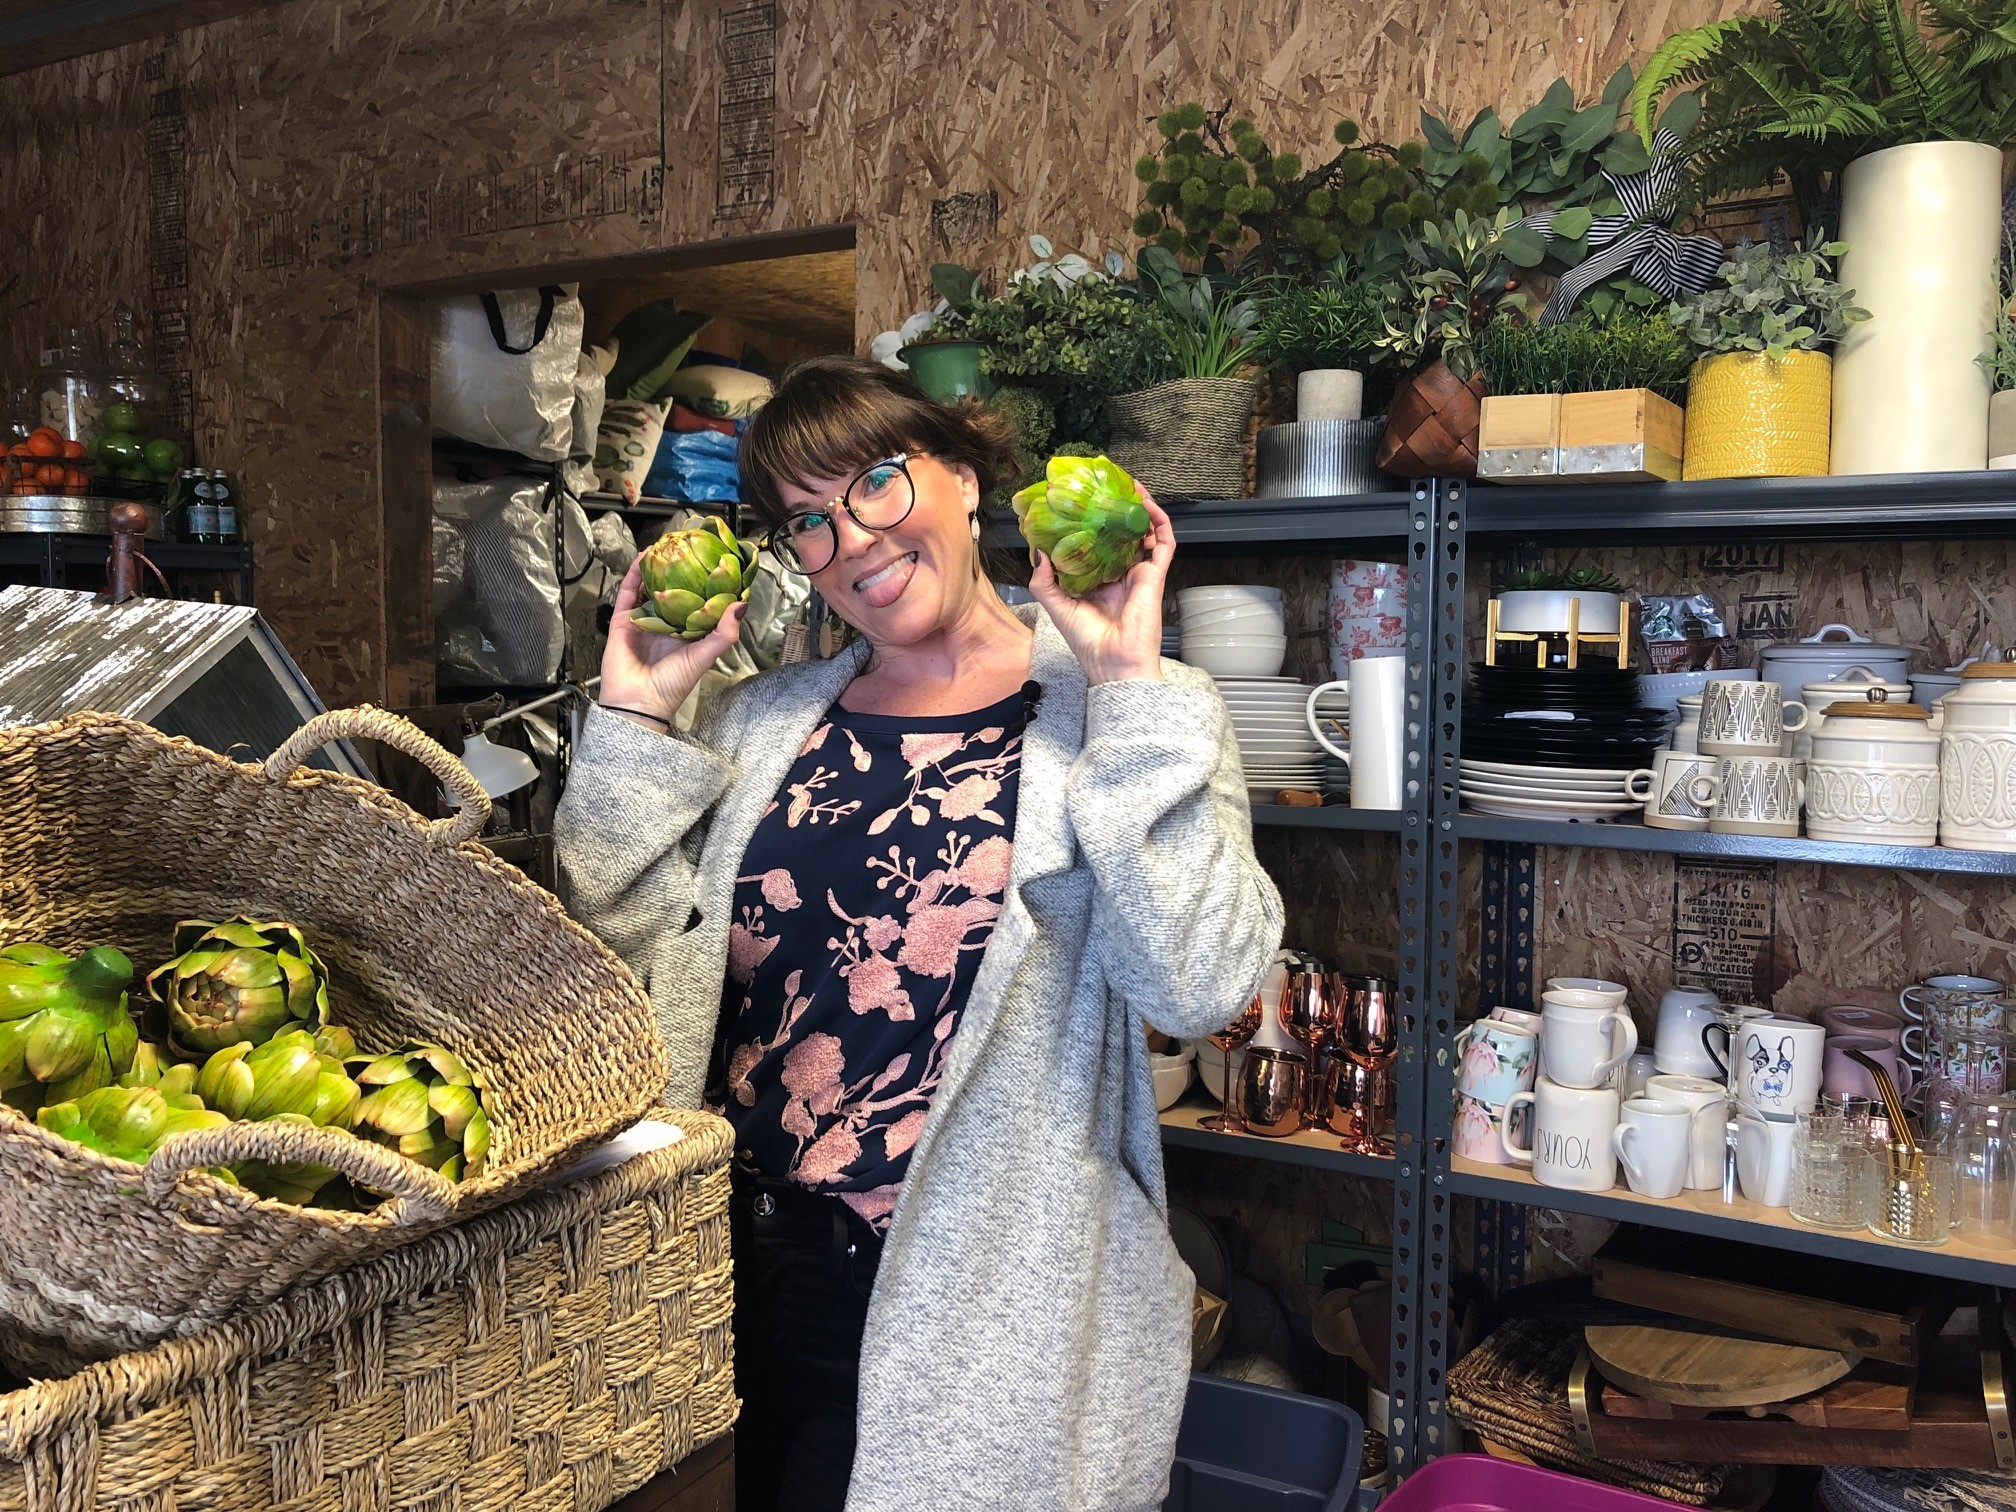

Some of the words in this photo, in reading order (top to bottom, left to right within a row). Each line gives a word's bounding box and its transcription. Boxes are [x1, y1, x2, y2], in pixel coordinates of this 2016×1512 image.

[1708, 543, 1775, 566] 2017
[1744, 602, 1793, 629] JAN
[1651, 646, 1688, 656] BREAKFAST
[1652, 656, 1670, 664] BLEND
[1710, 900, 1726, 909] FOR
[1691, 907, 1747, 918] EXPOSURE
[1682, 914, 1728, 926] THICKNESS
[1710, 927, 1737, 942] 510
